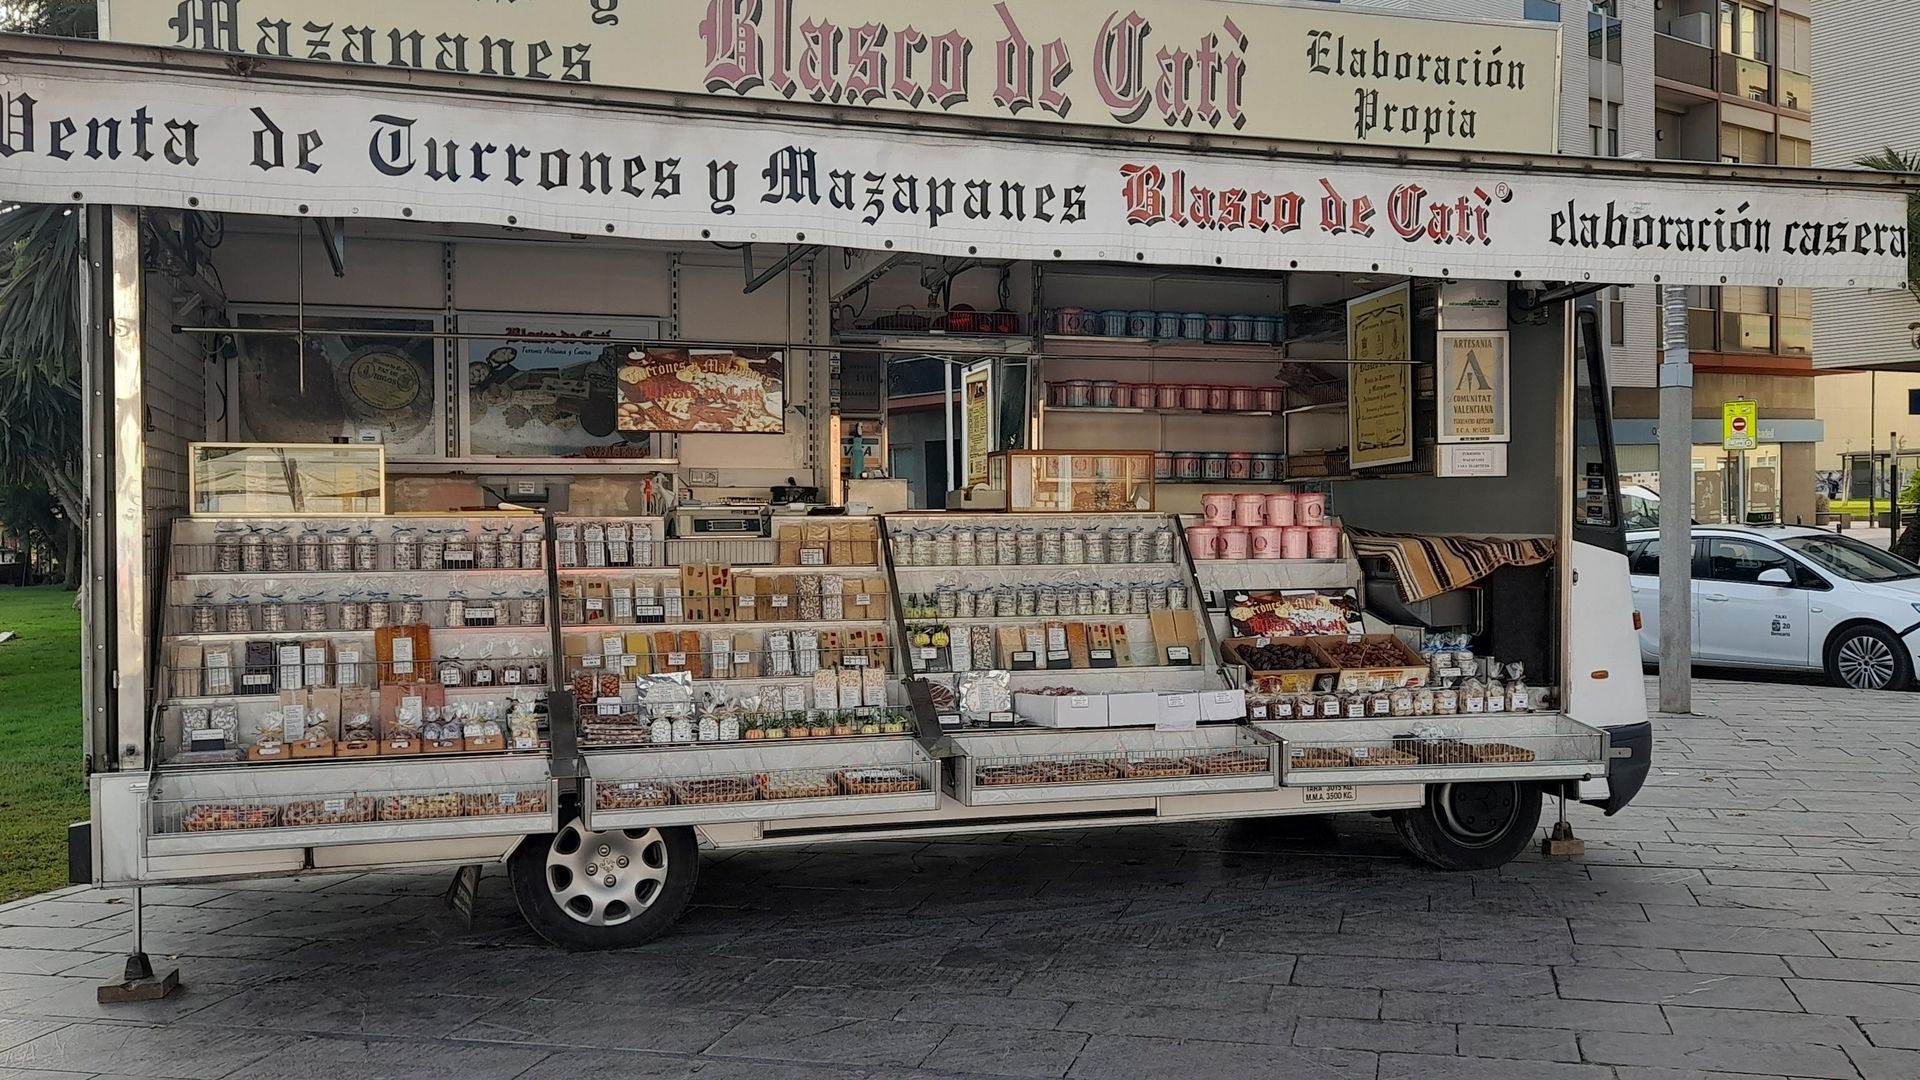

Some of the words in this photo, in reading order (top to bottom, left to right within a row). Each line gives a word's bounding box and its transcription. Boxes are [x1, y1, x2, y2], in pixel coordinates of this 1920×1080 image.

[699, 0, 971, 110] Blasco
[993, 2, 1073, 118] de
[1307, 29, 1525, 90] Elaboración
[1354, 87, 1476, 144] Propia
[249, 106, 323, 174] de
[368, 114, 681, 201] Turrones
[708, 157, 737, 216] y
[760, 144, 1087, 228] Mazapanes
[1121, 163, 1304, 234] Blasco
[1319, 178, 1377, 238] de
[1550, 198, 1770, 253] elaboración
[1782, 217, 1906, 259] casera
[1453, 339, 1493, 349] ARTESANIA
[1453, 395, 1492, 403] COMUNITAT
[1453, 405, 1494, 414] VALENCIANA
[843, 445, 872, 457] VA
[1326, 792, 1342, 800] 3500
